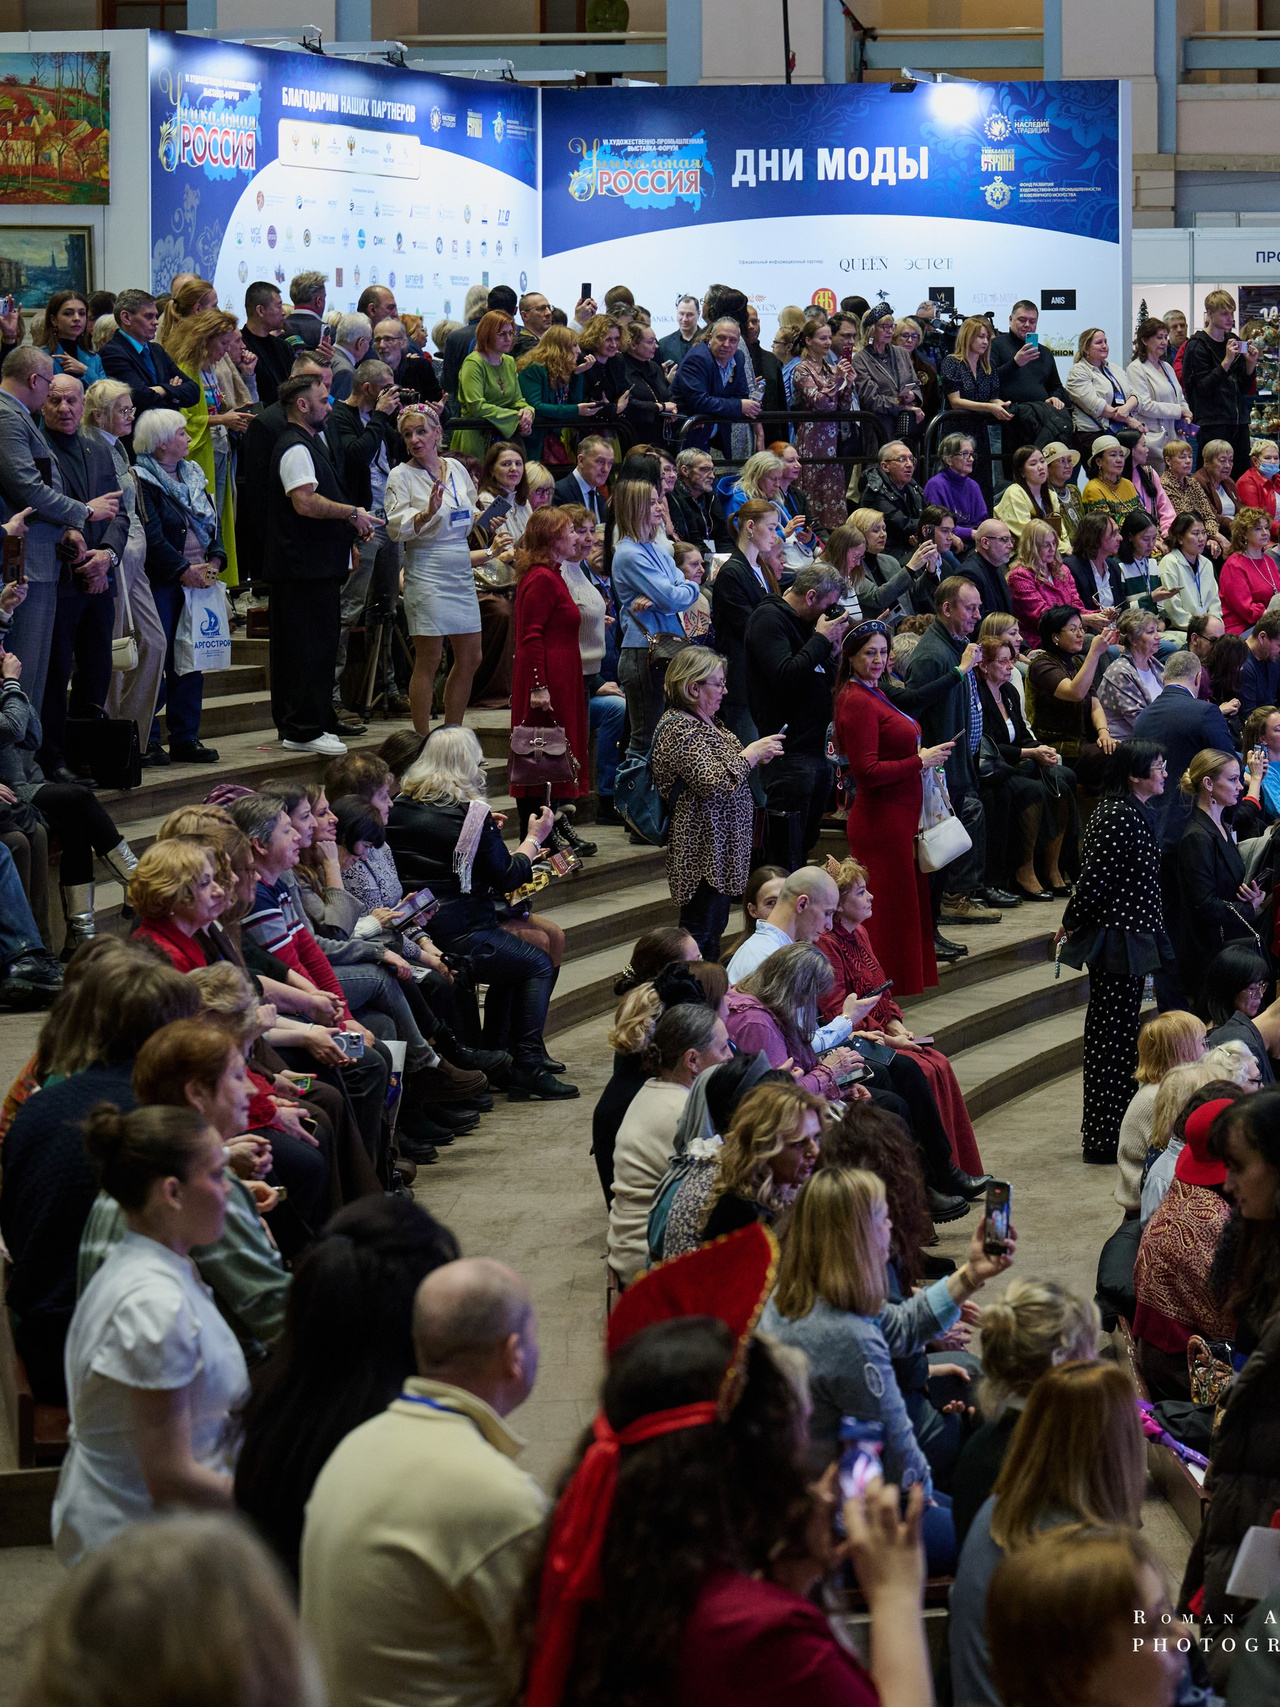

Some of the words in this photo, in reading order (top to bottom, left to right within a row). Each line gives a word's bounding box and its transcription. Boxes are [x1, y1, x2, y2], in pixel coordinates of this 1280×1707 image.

[282, 86, 339, 113] БЛАГОДАРИМ
[341, 95, 370, 117] НАШИХ
[371, 99, 416, 123] ПАРТНЕРОВ
[181, 124, 256, 171] РОССИЯ
[609, 138, 704, 146] ХУДОЖЕСТВЕННО-ПРОМЫШЛЕННАЯ
[731, 148, 803, 187] ДНИ
[817, 146, 929, 186] МОДЫ
[598, 169, 701, 195] РОССИЯ
[839, 258, 888, 272] QUEEN
[1050, 296, 1066, 305] ANIS
